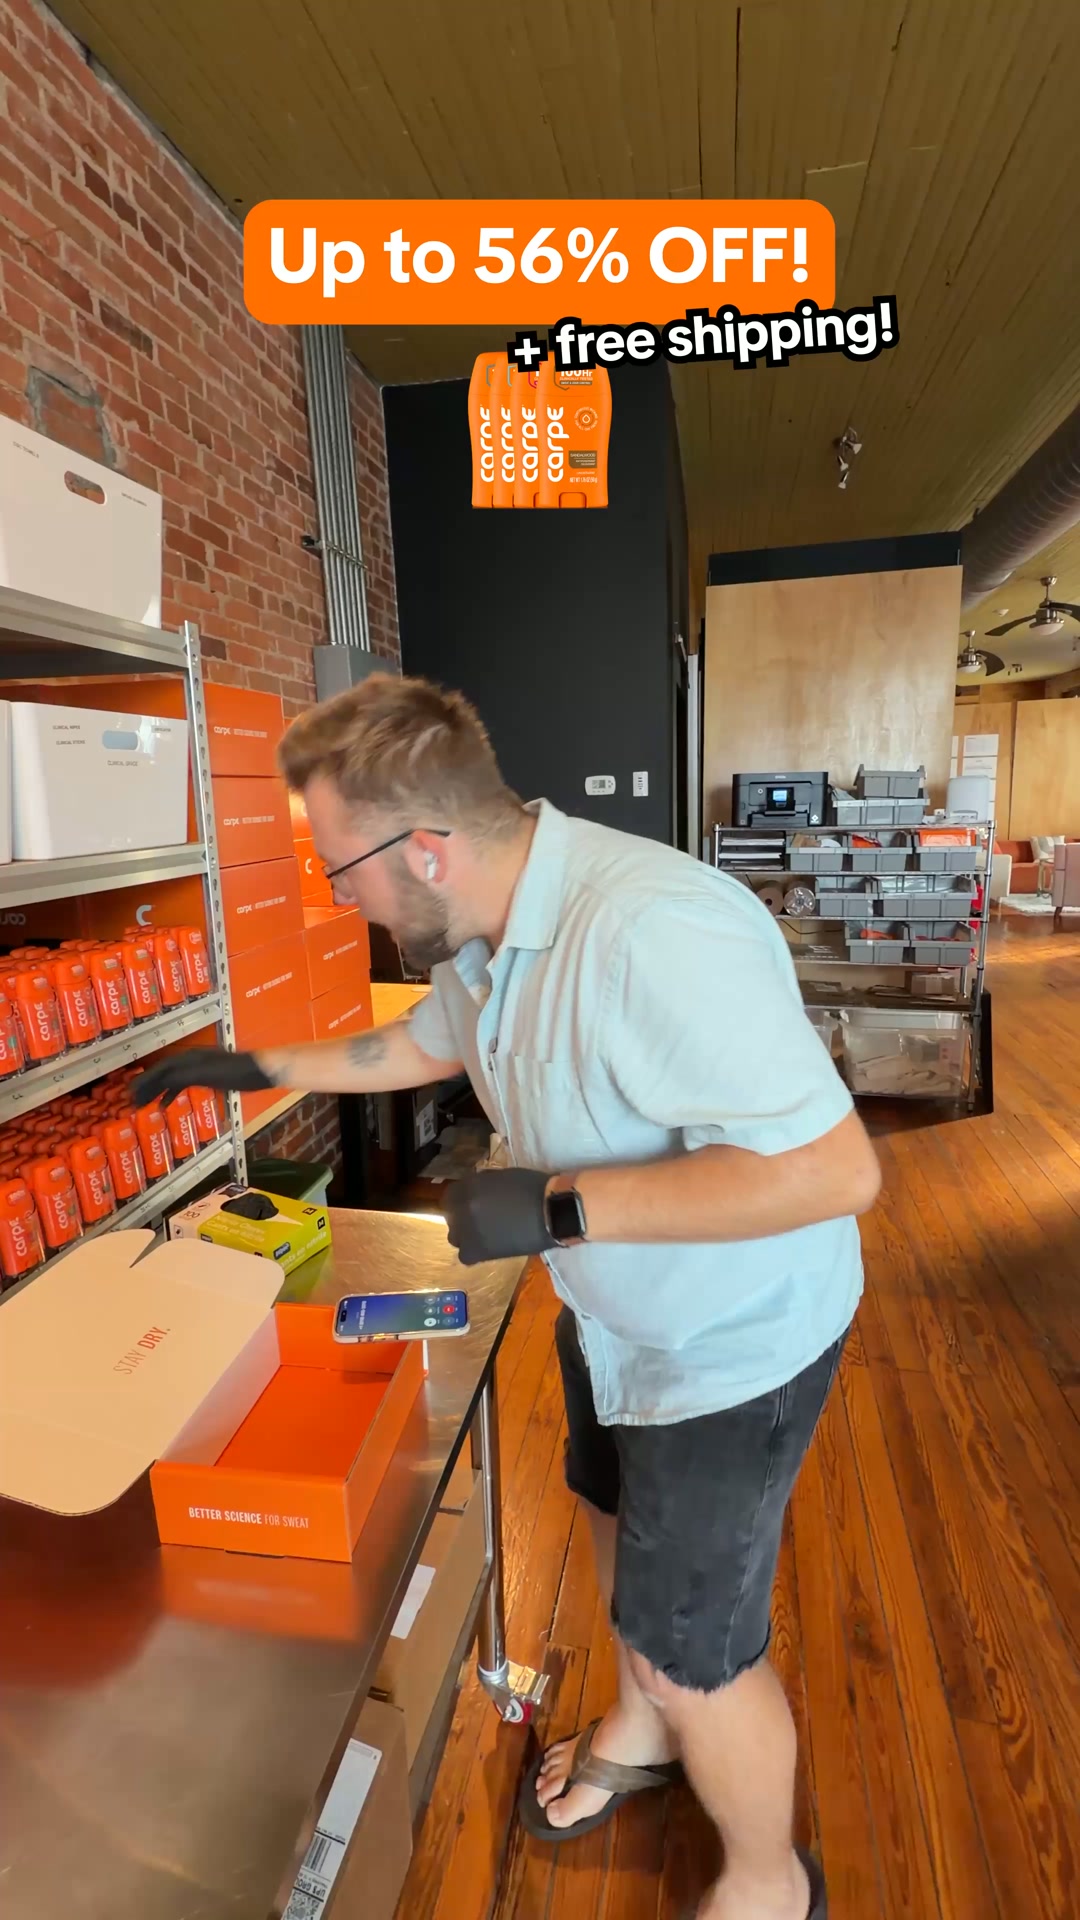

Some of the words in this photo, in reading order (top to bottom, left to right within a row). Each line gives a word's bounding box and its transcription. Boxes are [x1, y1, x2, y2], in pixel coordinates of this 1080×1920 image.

[106, 980, 120, 1016] carpe
[137, 970, 151, 1004] carpe
[34, 1002, 51, 1041] carpe
[73, 991, 89, 1027] carpe
[52, 1192, 69, 1229] carpe
[8, 1216, 28, 1257] carpe
[113, 1348, 147, 1375] STAY
[137, 1326, 171, 1350] DRY.
[188, 1506, 222, 1520] BETTER
[224, 1510, 262, 1524] SCIENCE
[264, 1513, 281, 1526] FOR
[282, 1515, 309, 1529] SWEAT
[312, 1885, 326, 1898] UPS
